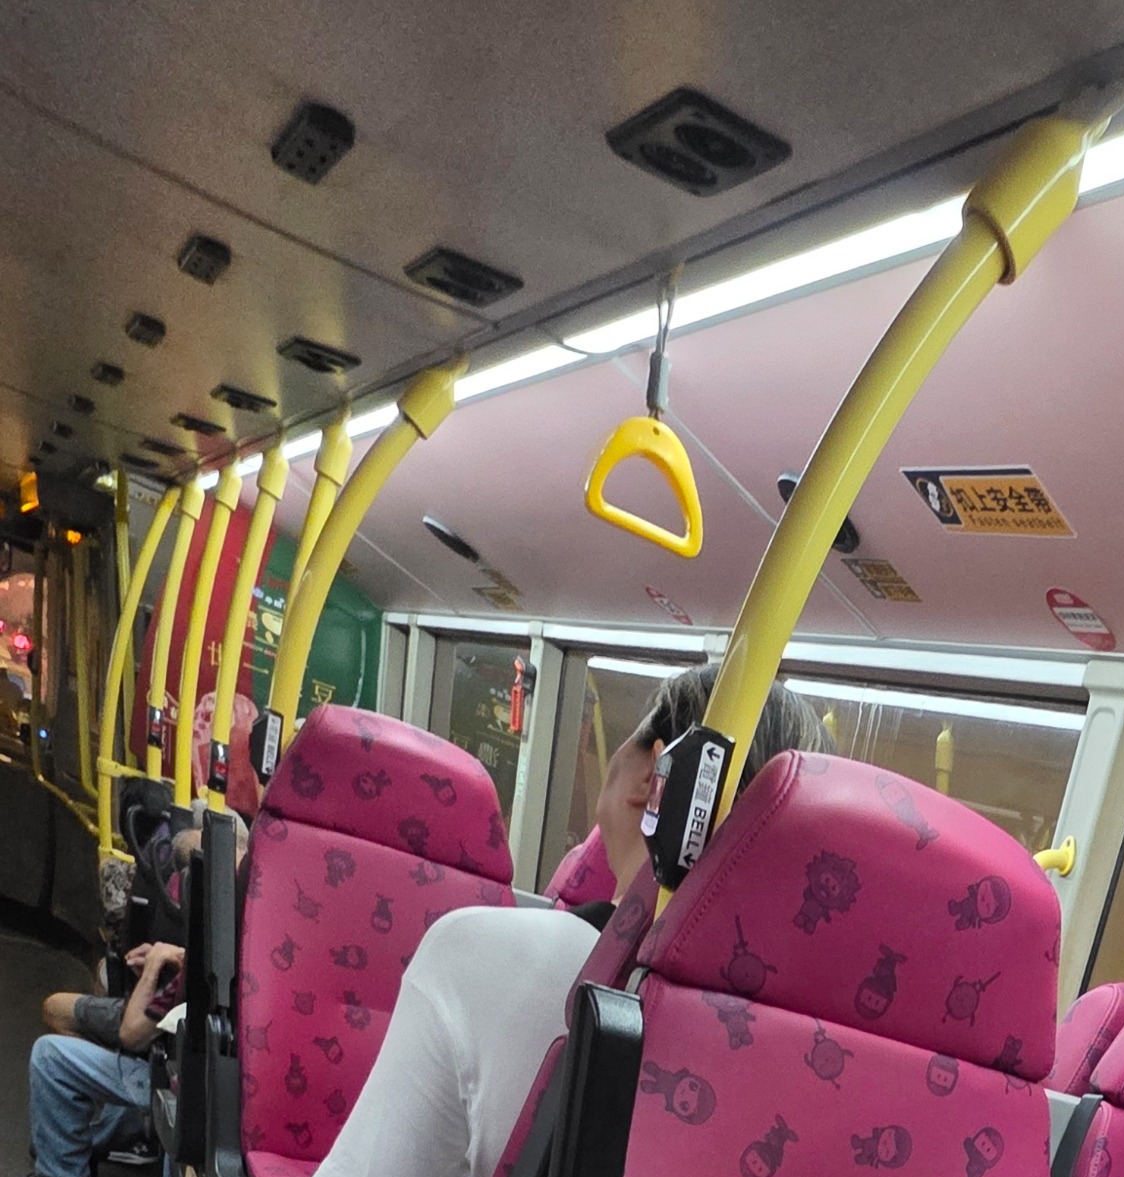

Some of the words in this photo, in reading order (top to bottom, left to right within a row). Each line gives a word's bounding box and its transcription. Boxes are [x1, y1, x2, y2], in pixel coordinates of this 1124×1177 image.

[949, 486, 1052, 514] 扣上安全帶
[686, 807, 707, 849] BELL
